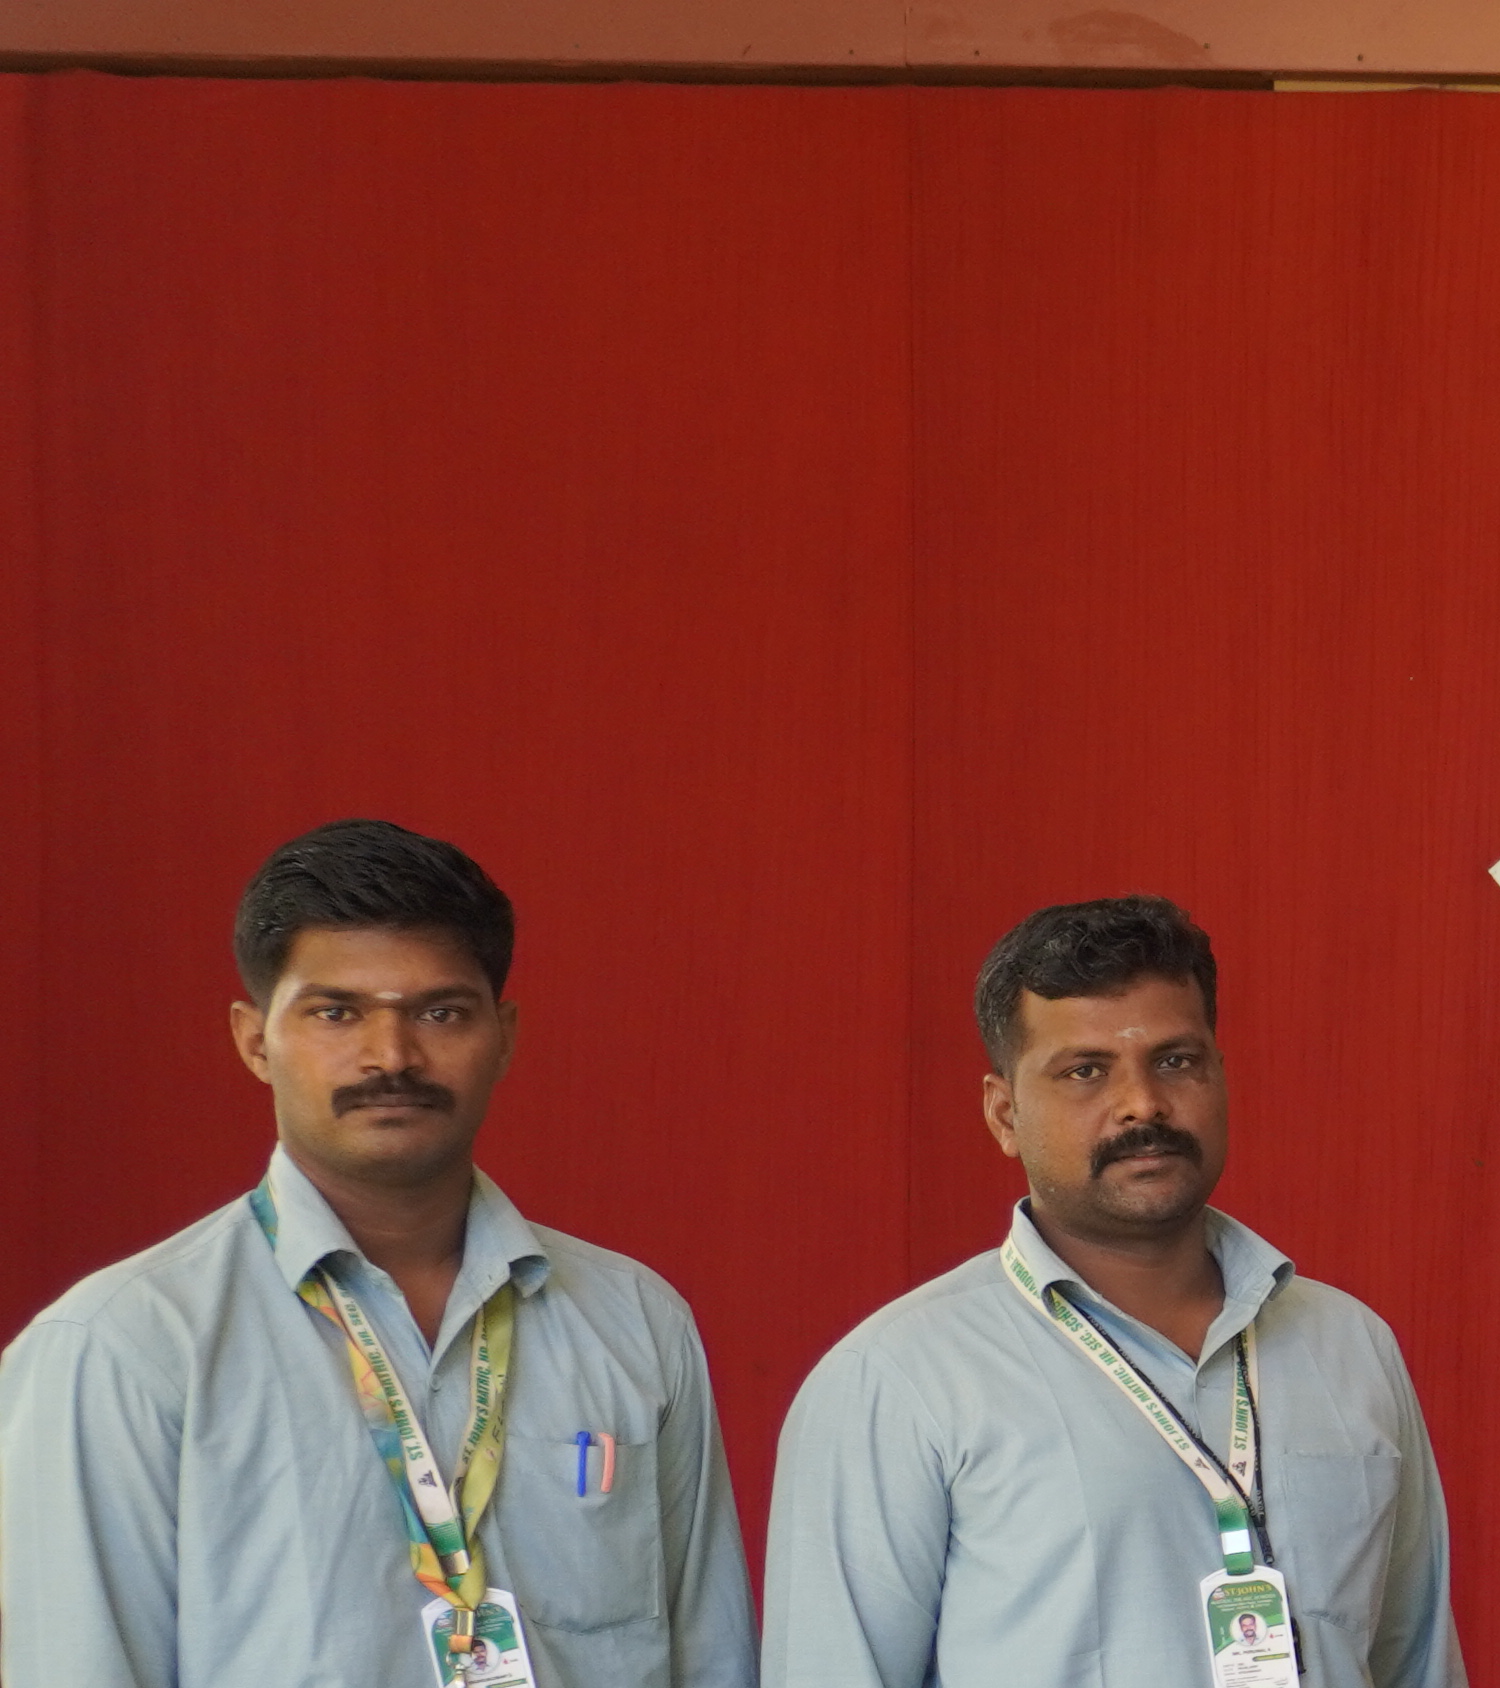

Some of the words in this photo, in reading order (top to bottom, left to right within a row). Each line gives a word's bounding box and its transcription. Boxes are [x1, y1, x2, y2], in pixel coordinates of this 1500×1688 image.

[1079, 1329, 1102, 1351] SEC.
[1098, 1346, 1119, 1366] HR.
[1114, 1363, 1152, 1403] MATRIC.
[389, 1398, 417, 1440] JOHN'S
[468, 1406, 488, 1446] JOHN'S
[1146, 1402, 1178, 1436] JOHN'S
[1235, 1398, 1249, 1433] JOHN'S
[406, 1440, 424, 1461] ST.
[1234, 1435, 1248, 1451] ST.
